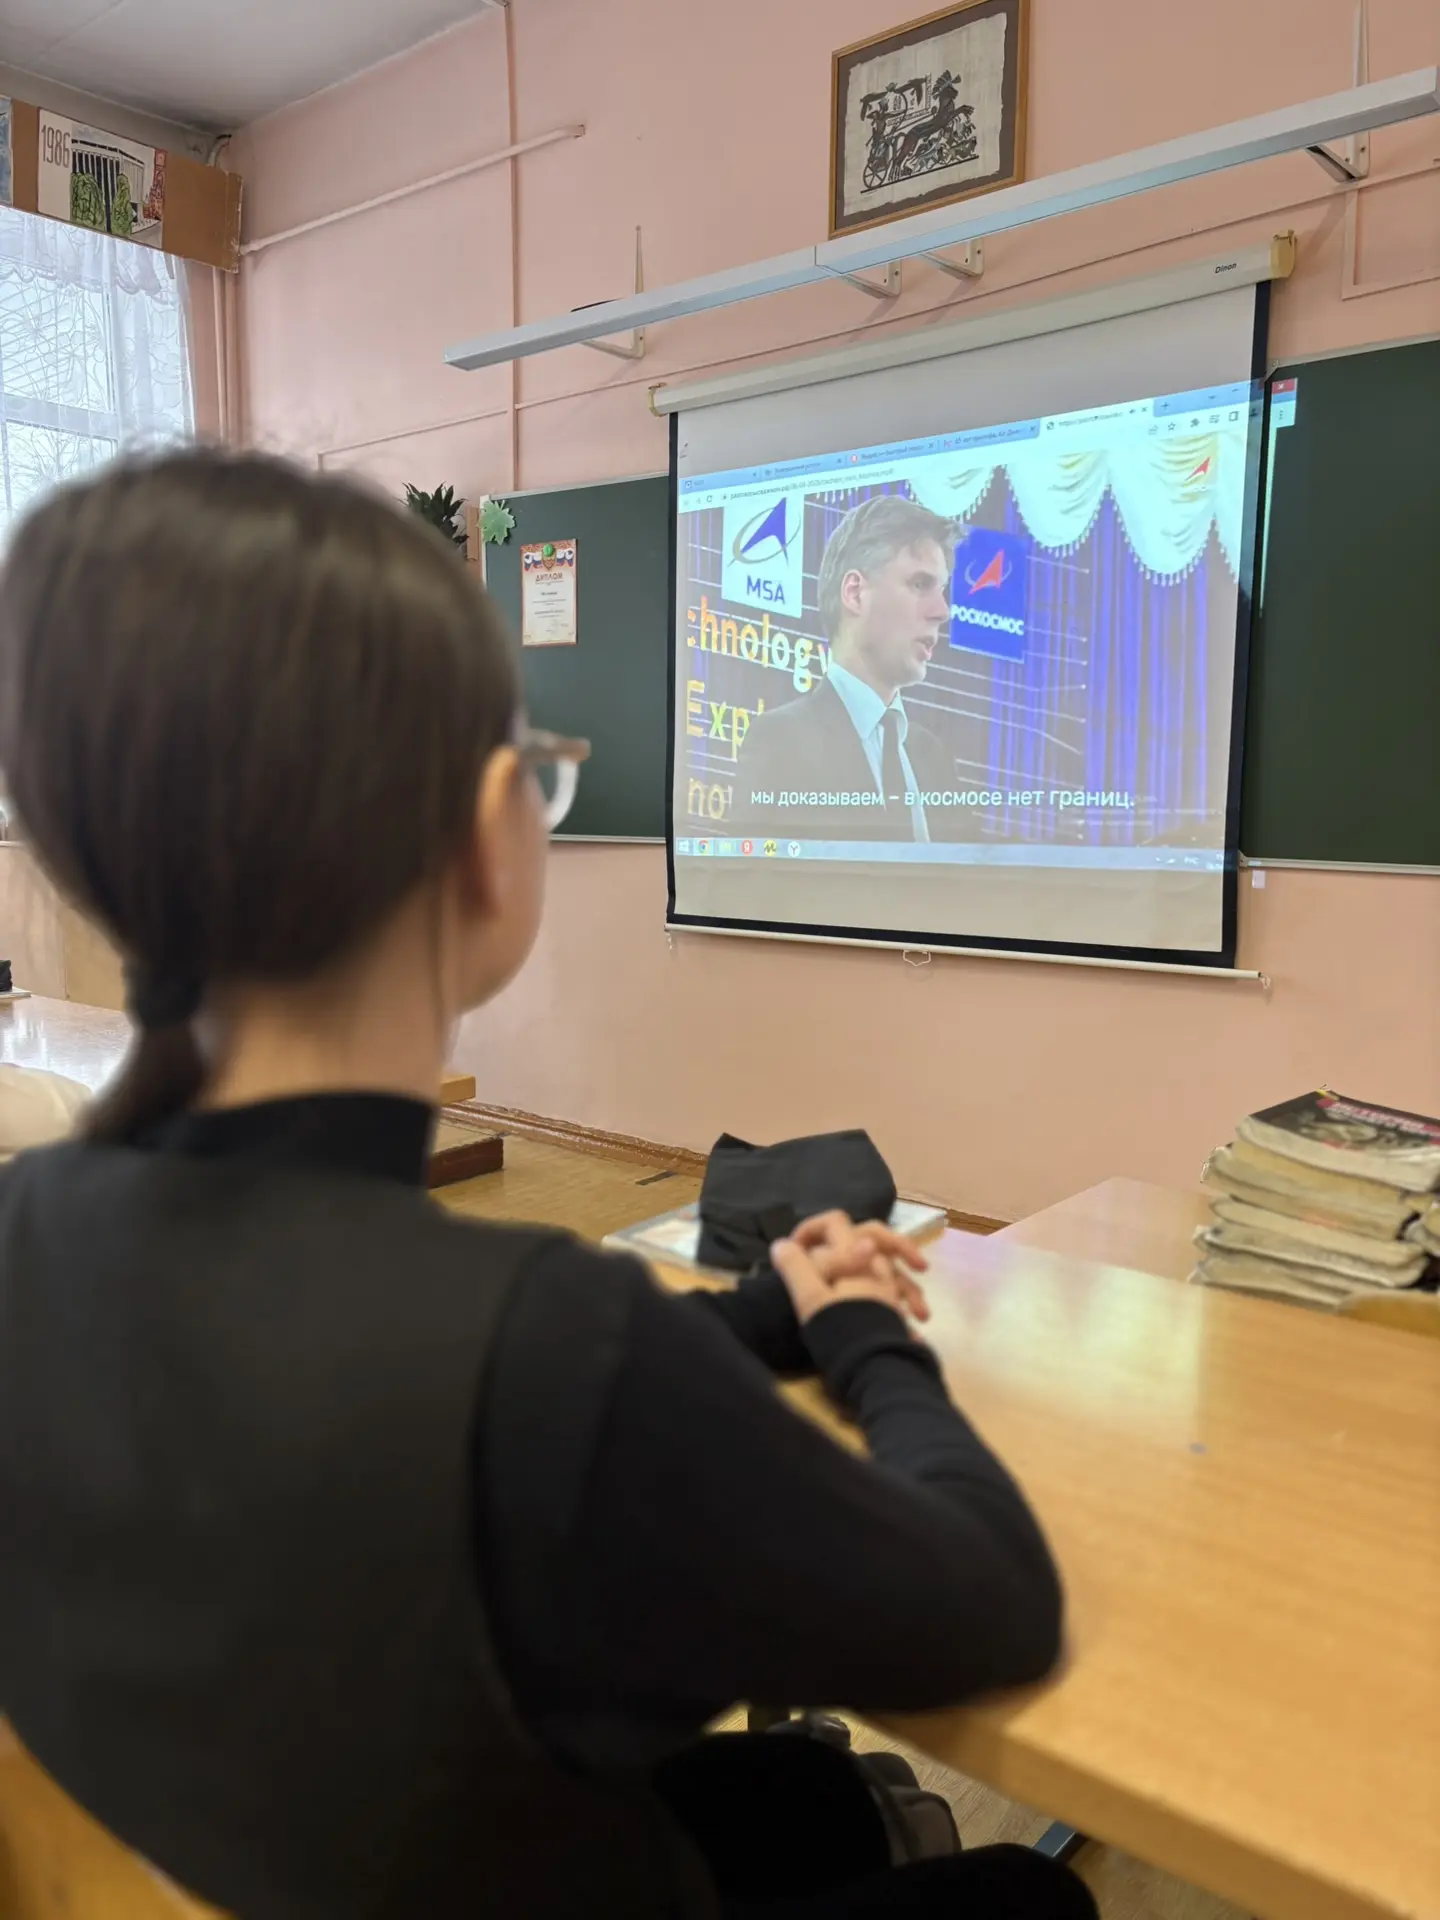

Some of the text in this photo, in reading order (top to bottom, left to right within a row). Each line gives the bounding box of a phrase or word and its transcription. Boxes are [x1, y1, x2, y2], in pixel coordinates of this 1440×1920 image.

[41, 124, 71, 168] 1986
[746, 575, 786, 605] MSA
[950, 604, 1025, 636] РОСКОСМОС
[686, 679, 765, 762] Exp
[750, 791, 774, 805] мы
[777, 790, 885, 807] доказываем
[904, 791, 915, 806] в
[920, 790, 1003, 806] космосе
[1008, 790, 1045, 806] нет
[1050, 790, 1135, 810] границ.
